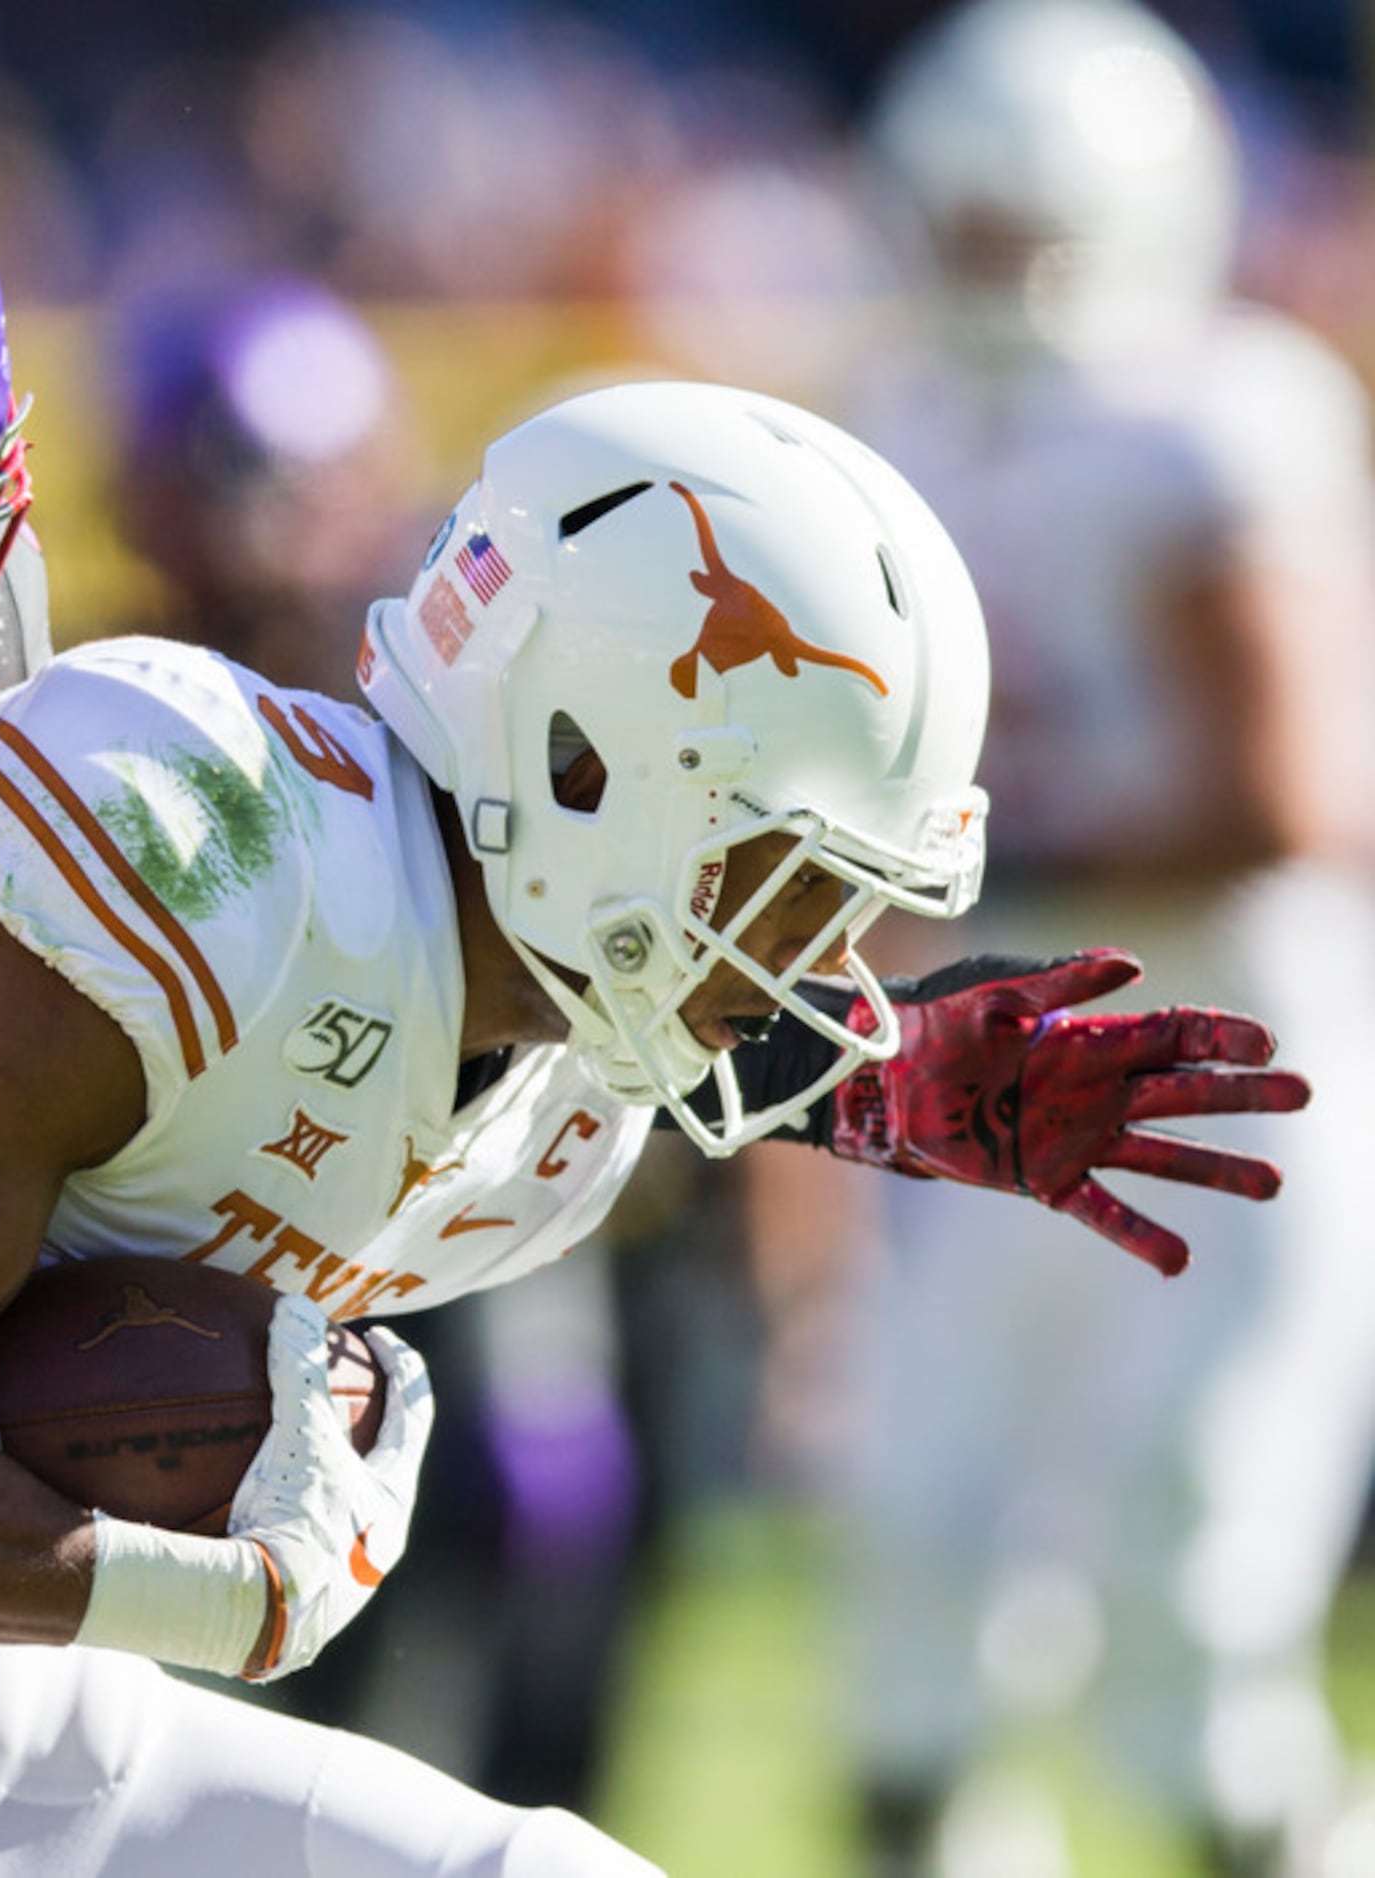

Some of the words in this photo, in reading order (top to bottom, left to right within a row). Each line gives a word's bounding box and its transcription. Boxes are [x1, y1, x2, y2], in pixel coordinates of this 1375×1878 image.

[284, 1000, 393, 1088] 150
[260, 1106, 349, 1181] XII
[535, 1109, 601, 1179] C
